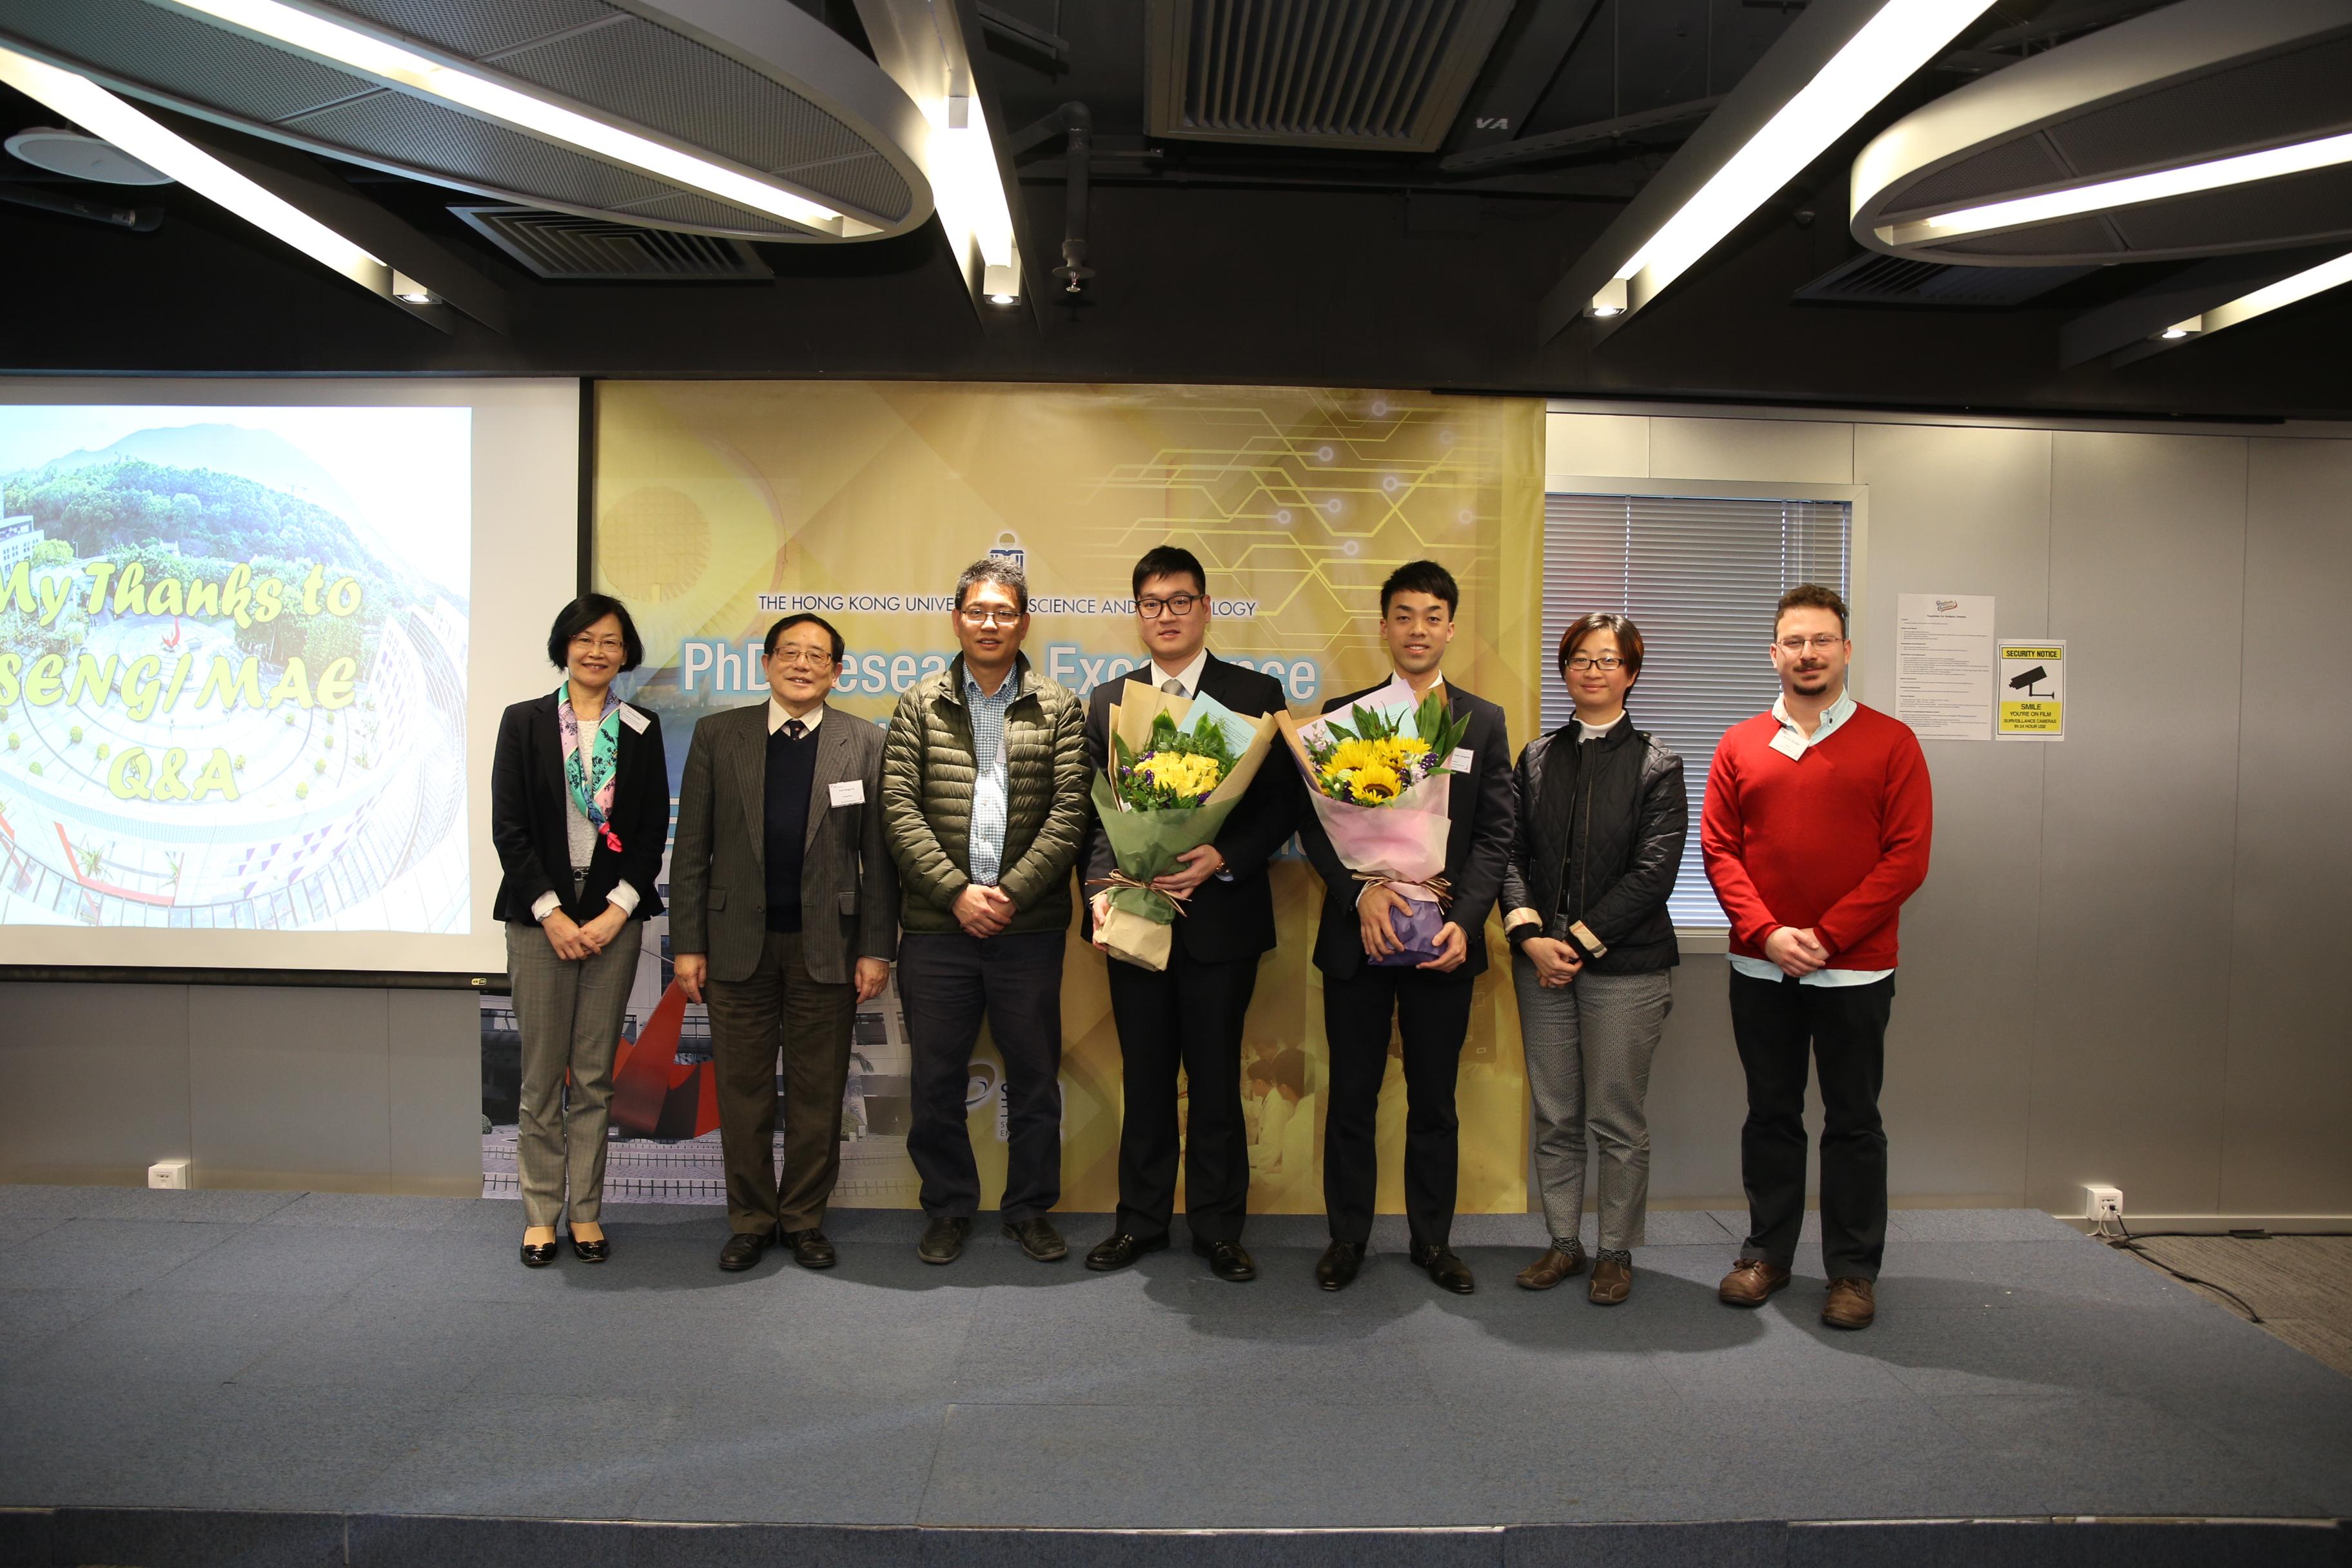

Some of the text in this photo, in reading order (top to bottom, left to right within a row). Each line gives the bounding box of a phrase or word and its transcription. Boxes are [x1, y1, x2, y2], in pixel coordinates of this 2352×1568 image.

[0, 560, 362, 629] My Thanks to
[759, 596, 1136, 614] THE HONG KONG UNIVE SCIENCE AND
[195, 656, 357, 710] MAE
[684, 642, 771, 691] PhD
[108, 747, 240, 801] Q&A
